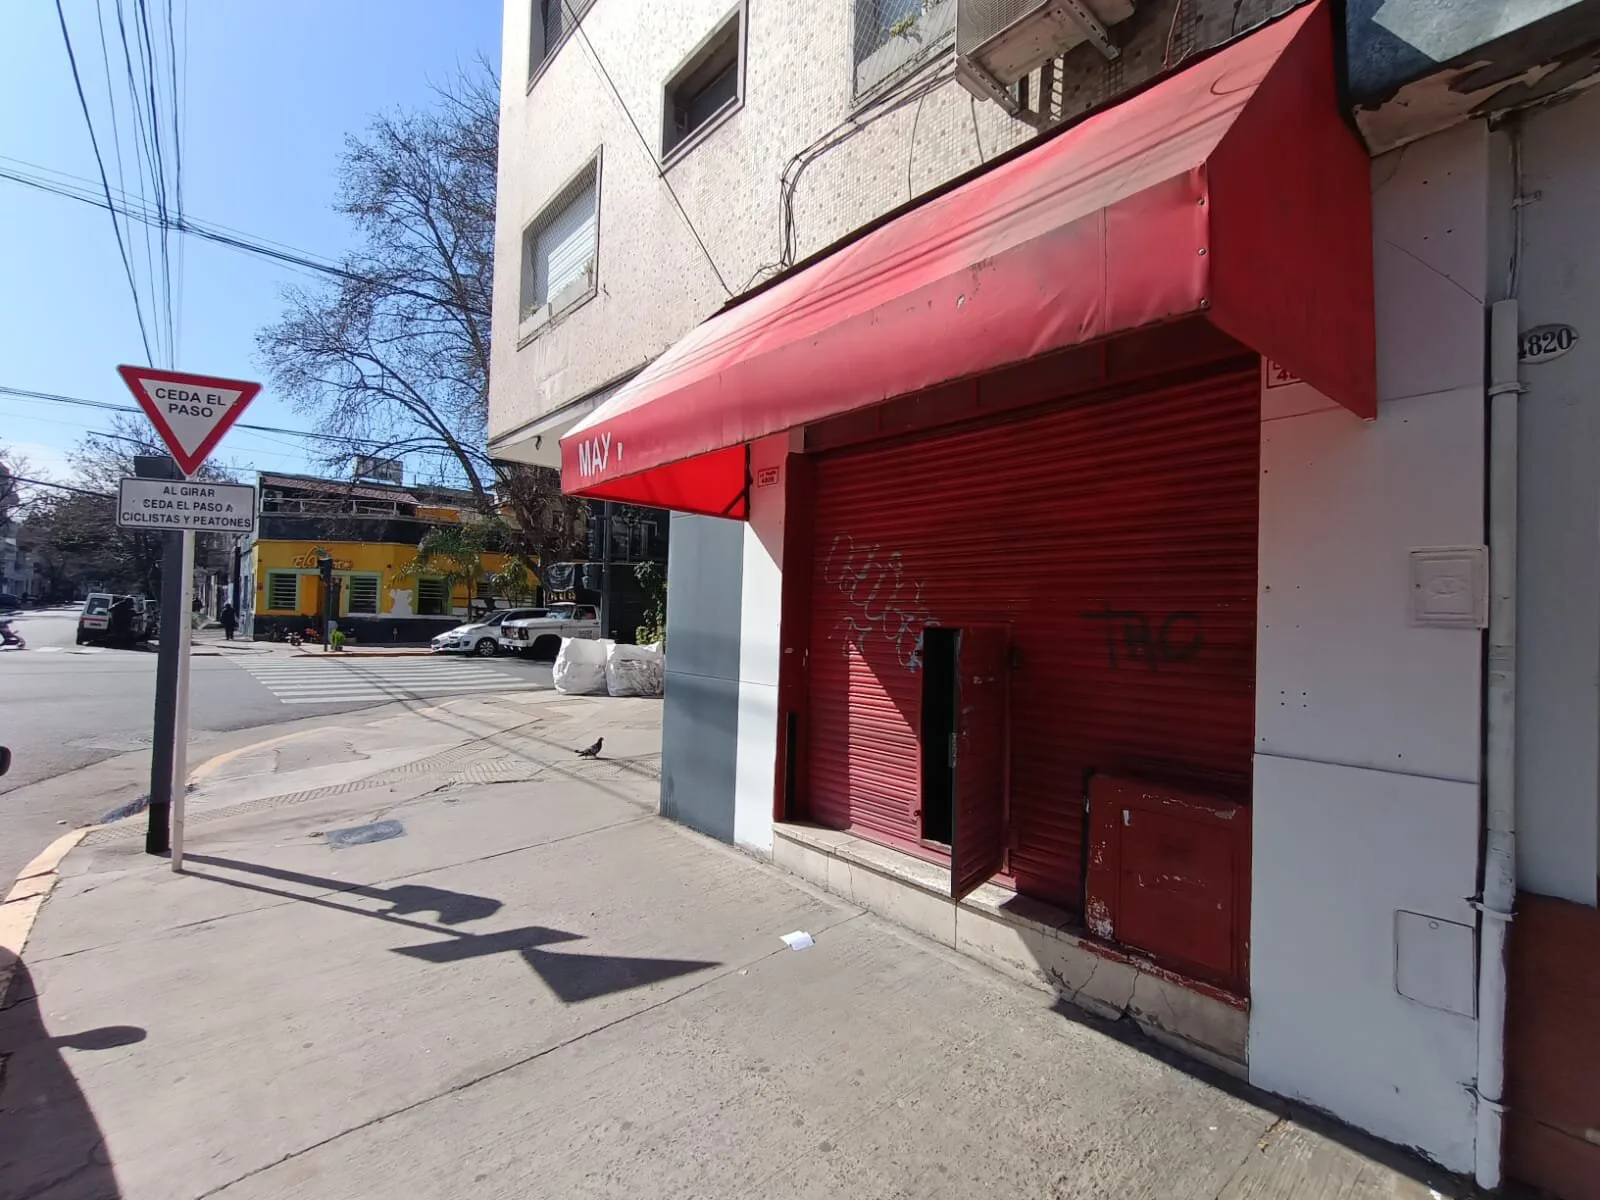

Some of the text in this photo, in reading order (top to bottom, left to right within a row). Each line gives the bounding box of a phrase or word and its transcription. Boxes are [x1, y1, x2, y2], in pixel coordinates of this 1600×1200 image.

[155, 387, 226, 407] CEDA EL
[168, 403, 213, 418] PASO
[578, 431, 611, 477] MAY
[163, 486, 216, 498] AL GIRAR
[176, 500, 190, 511] EL
[193, 502, 223, 513] PASO
[122, 511, 251, 529] CICLISTAS Y PEATONES
